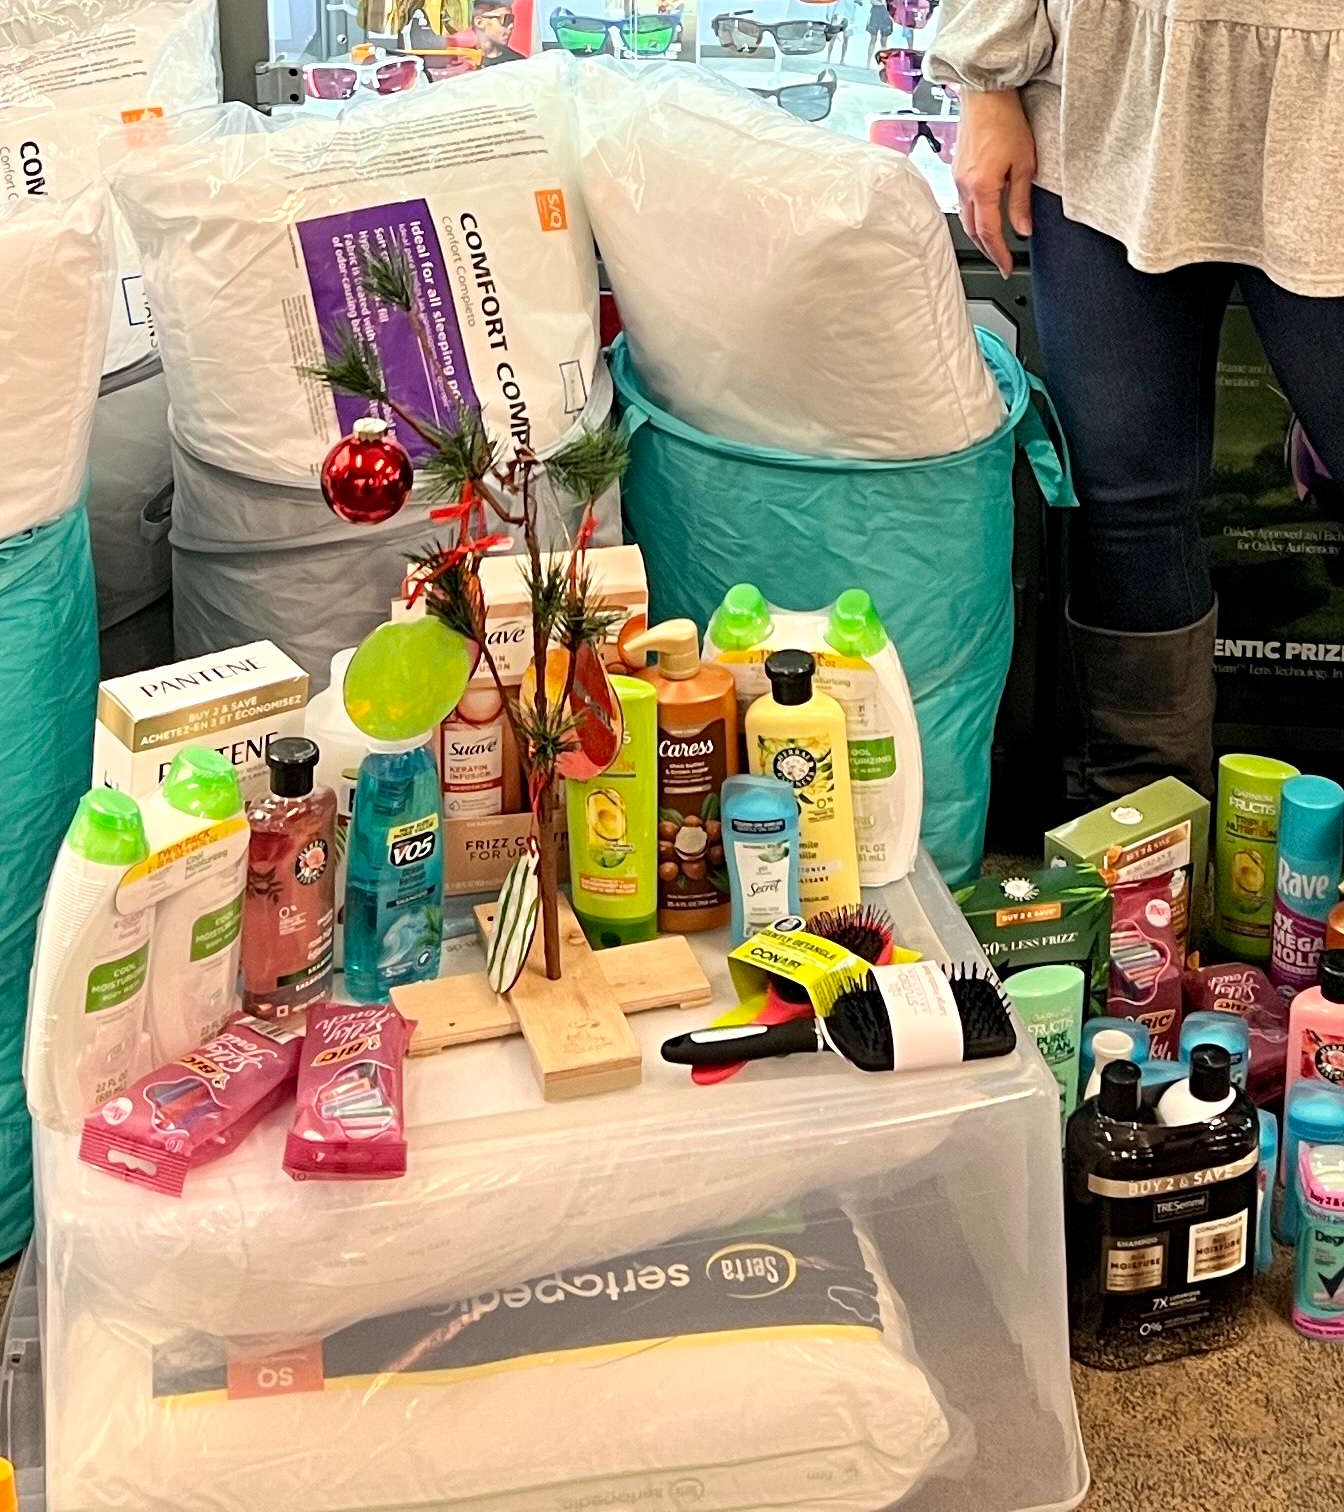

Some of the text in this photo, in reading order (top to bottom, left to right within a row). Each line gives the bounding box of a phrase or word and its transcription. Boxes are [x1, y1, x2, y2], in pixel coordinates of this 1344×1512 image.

[441, 215, 476, 328] Confort Completo
[460, 212, 508, 351] COMFORT
[335, 249, 358, 319] odor-causing
[409, 220, 455, 376] Ideal for all sleeping
[1222, 525, 1256, 540] Oakley
[1257, 527, 1304, 542] Approved
[1304, 529, 1323, 542] and
[1236, 539, 1250, 551] for
[1251, 540, 1284, 554] Oakley
[1214, 639, 1281, 660] ENTIC
[139, 656, 268, 698] PANTENE
[188, 695, 258, 723] BUY SAVE
[140, 694, 304, 746] ACHETEZ-EN ET ÉCONOMISEZ
[449, 737, 497, 756] Suave
[658, 739, 714, 758] Caress
[449, 763, 489, 774] KERATIN
[1228, 797, 1276, 815] FRUCTIS
[393, 834, 432, 865] VO5
[465, 838, 510, 852] FRIZZ
[469, 849, 501, 862] FOR
[747, 878, 783, 897] Secret
[1277, 856, 1329, 900] Rave
[1011, 932, 1078, 951] LESS FRIZZ
[1273, 930, 1324, 952] MEGA
[749, 946, 803, 970] CONAIR
[1272, 940, 1321, 968] HOLD
[1142, 1014, 1172, 1029] BIC
[1036, 1030, 1068, 1047] PURE
[1129, 1165, 1235, 1197] BUY 2 SAVE
[1196, 1238, 1241, 1256] MOISTURE
[720, 1256, 779, 1285] Serta
[1110, 1257, 1161, 1270] MOISTURE
[1152, 1295, 1169, 1311] 7X
[256, 1365, 295, 1390] SQ
